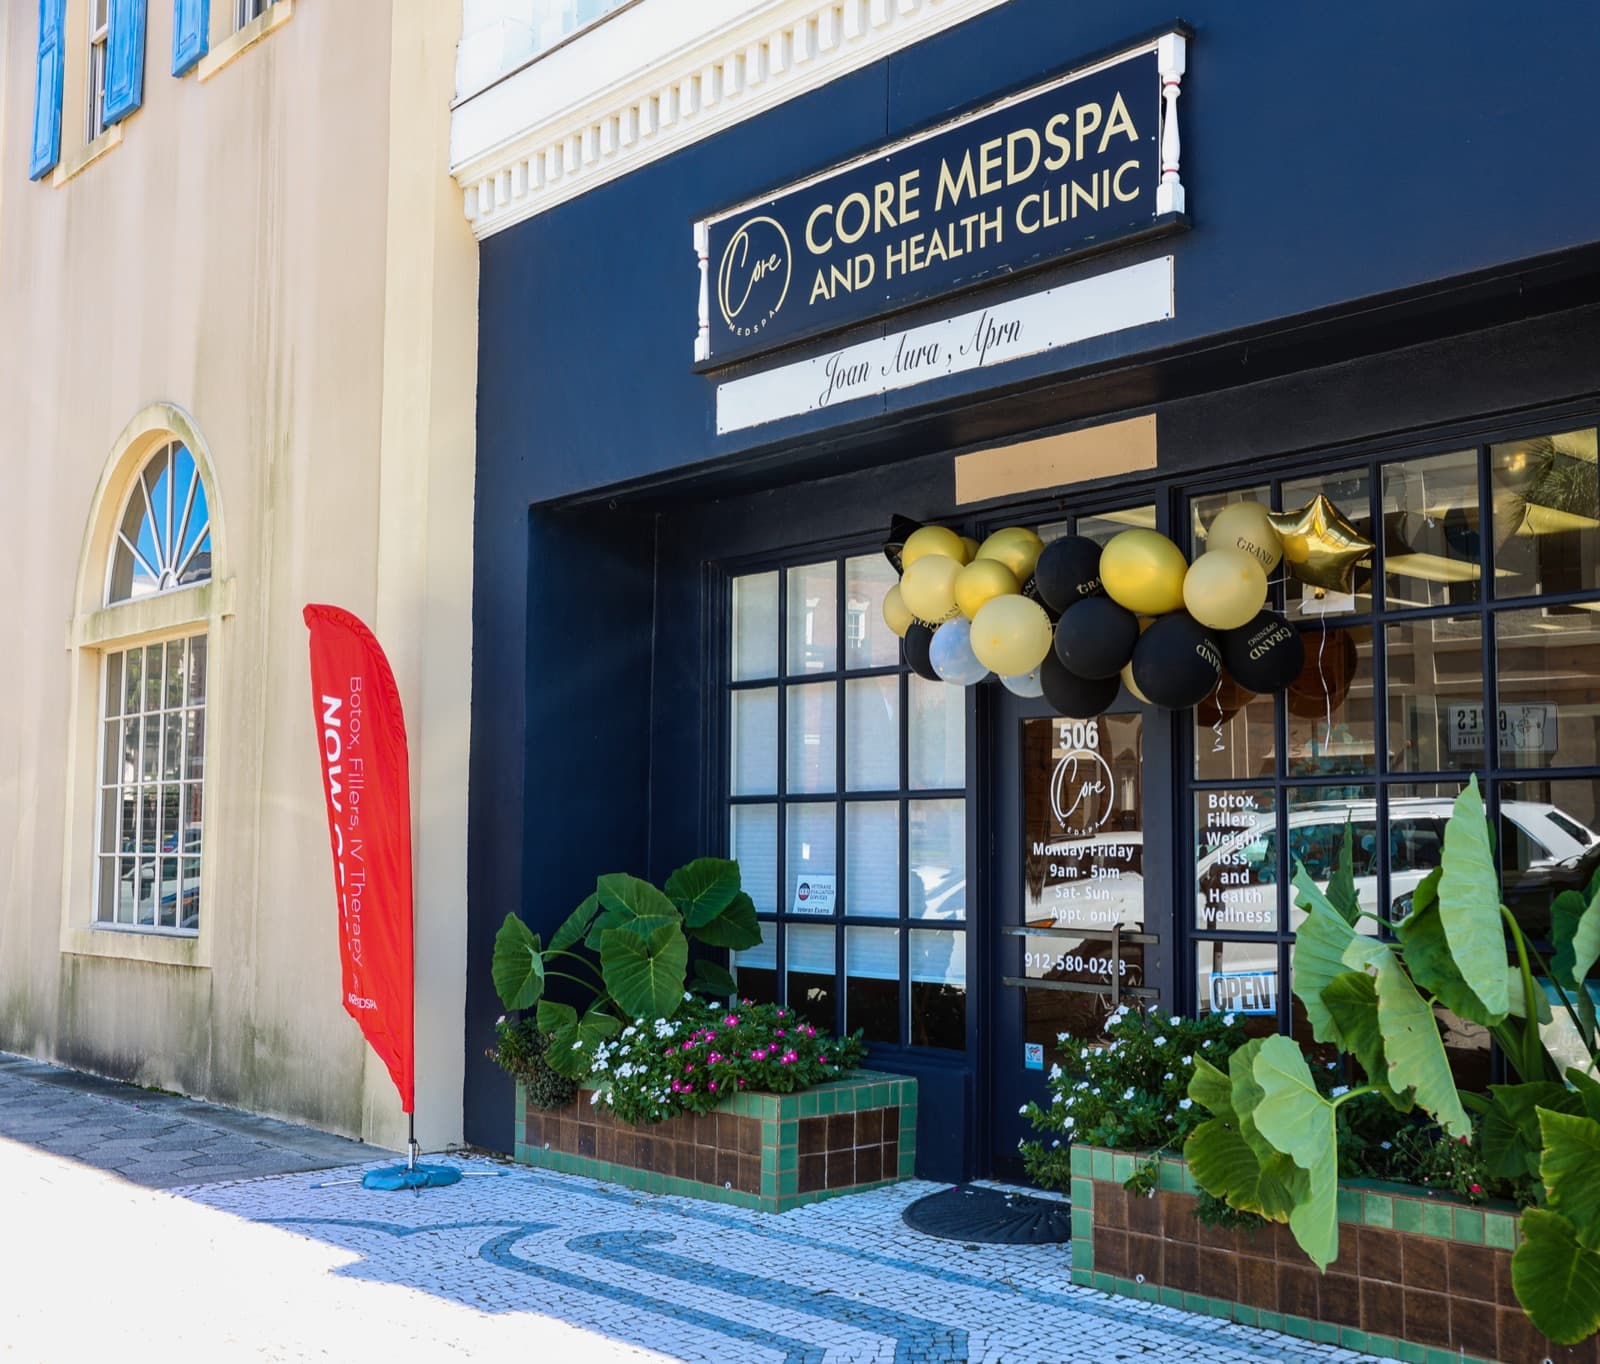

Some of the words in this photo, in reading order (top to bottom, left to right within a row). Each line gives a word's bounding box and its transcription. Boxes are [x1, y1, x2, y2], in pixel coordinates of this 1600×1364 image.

[805, 170, 920, 255] CORE
[935, 91, 1140, 211] MEDSPA
[809, 253, 875, 305] AND
[886, 206, 1003, 280] HEALTH
[1016, 160, 1140, 234] CLINIC
[725, 231, 782, 317] Core
[728, 309, 776, 337] MEDSPA
[818, 351, 870, 407] Joan
[959, 310, 1023, 367] Aprn
[1235, 536, 1274, 566] GRAND
[1249, 626, 1293, 660] GRAND
[347, 676, 362, 751] Botox,
[1059, 720, 1099, 750] 506
[347, 758, 366, 832] Fillers,
[1056, 755, 1106, 818] Core
[1208, 794, 1259, 810] Botox,
[349, 839, 365, 863] IV
[1032, 842, 1134, 861] Monday-Friday
[1217, 850, 1252, 867] loss,
[1049, 863, 1078, 878] 9am
[1090, 864, 1120, 883] 5pm
[1220, 869, 1250, 884] and
[1209, 888, 1263, 904] Health
[350, 867, 366, 968] Therapy
[1049, 906, 1085, 924] Appt.
[1090, 908, 1120, 926] only
[1201, 907, 1272, 923] Wellness
[1213, 976, 1271, 1010] OPEN
